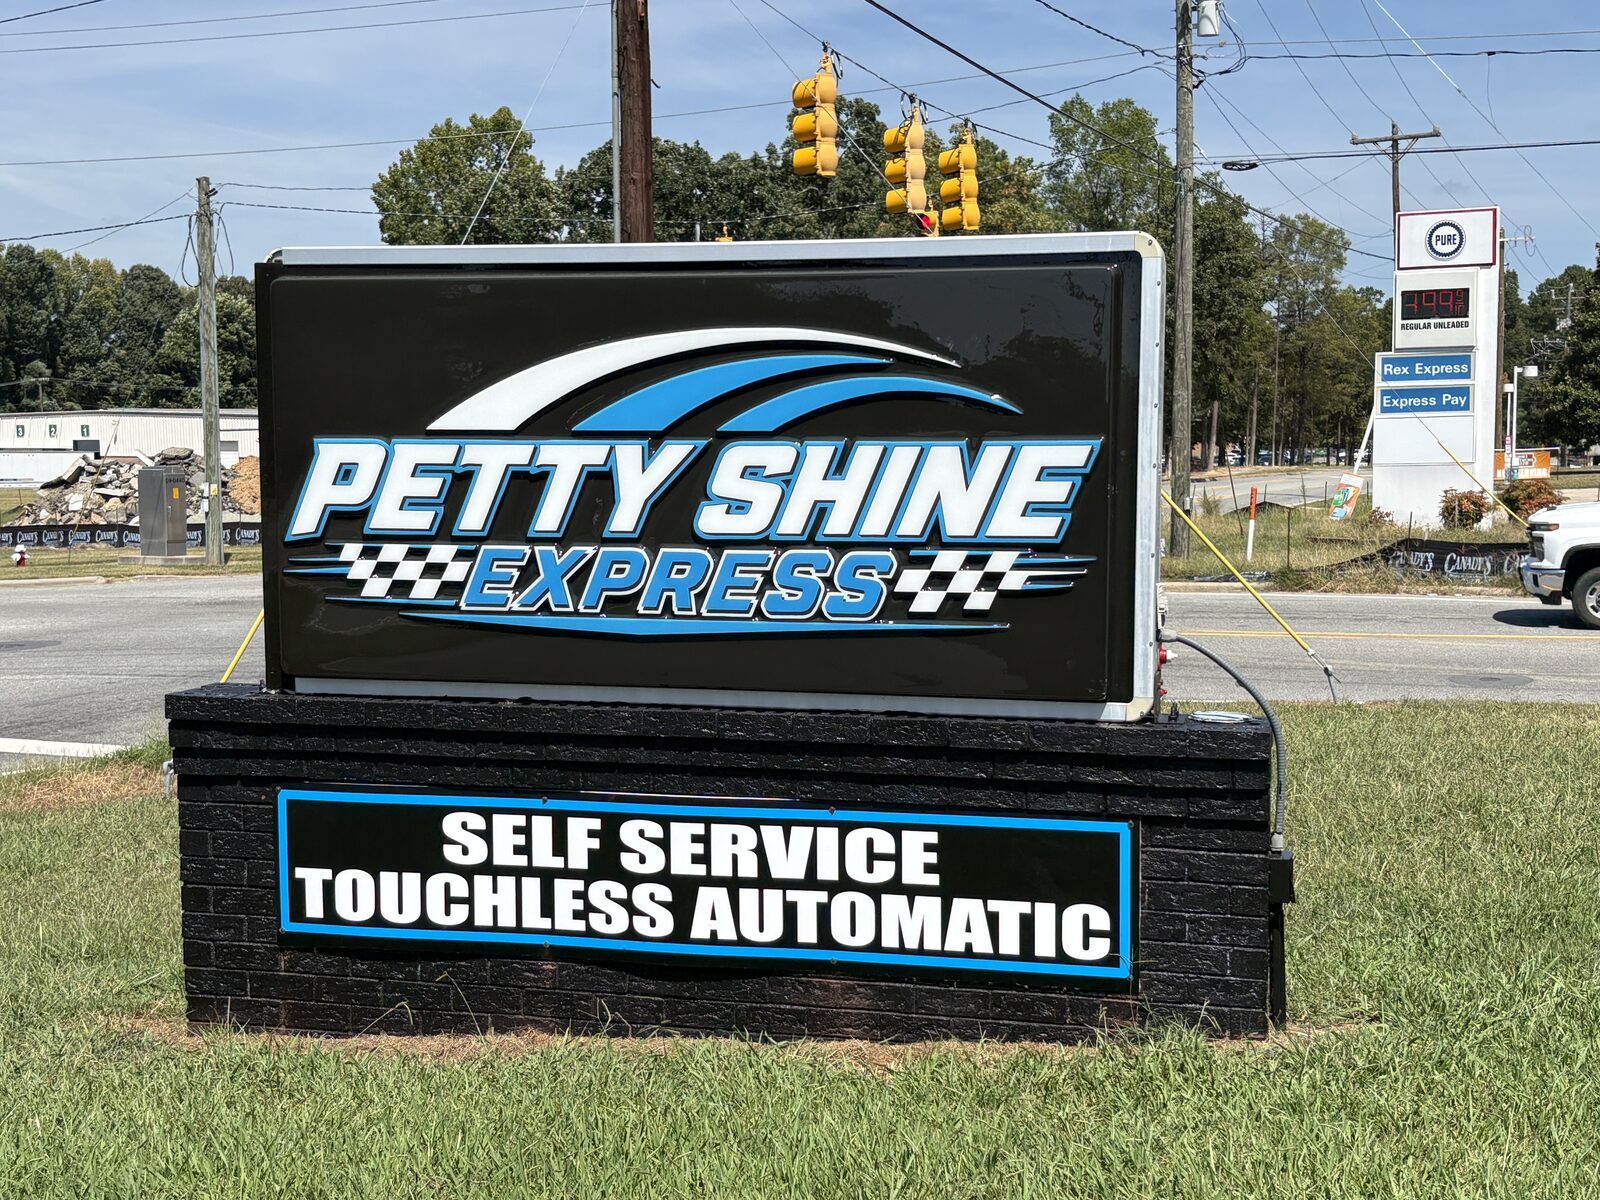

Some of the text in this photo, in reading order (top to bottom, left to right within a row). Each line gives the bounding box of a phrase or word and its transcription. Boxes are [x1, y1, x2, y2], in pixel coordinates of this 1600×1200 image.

[1435, 234, 1457, 246] PURE
[1401, 320, 1469, 331] REGULAR UNLEADED
[1383, 362, 1469, 376] Rex Express
[1382, 393, 1467, 409] Express Pay
[17, 427, 23, 436] 3
[50, 427, 56, 436] 2
[83, 427, 88, 436] 1
[285, 437, 1102, 542] PETTY SHINE
[95, 529, 118, 543] CANADY'S
[235, 528, 260, 541] CANADY'S
[1444, 552, 1493, 576] CANADY'S
[460, 544, 898, 621] EXPRESS
[441, 811, 941, 887] SELF SERVICE
[294, 866, 1112, 962] TOUCHLESS AUTOMATIC
